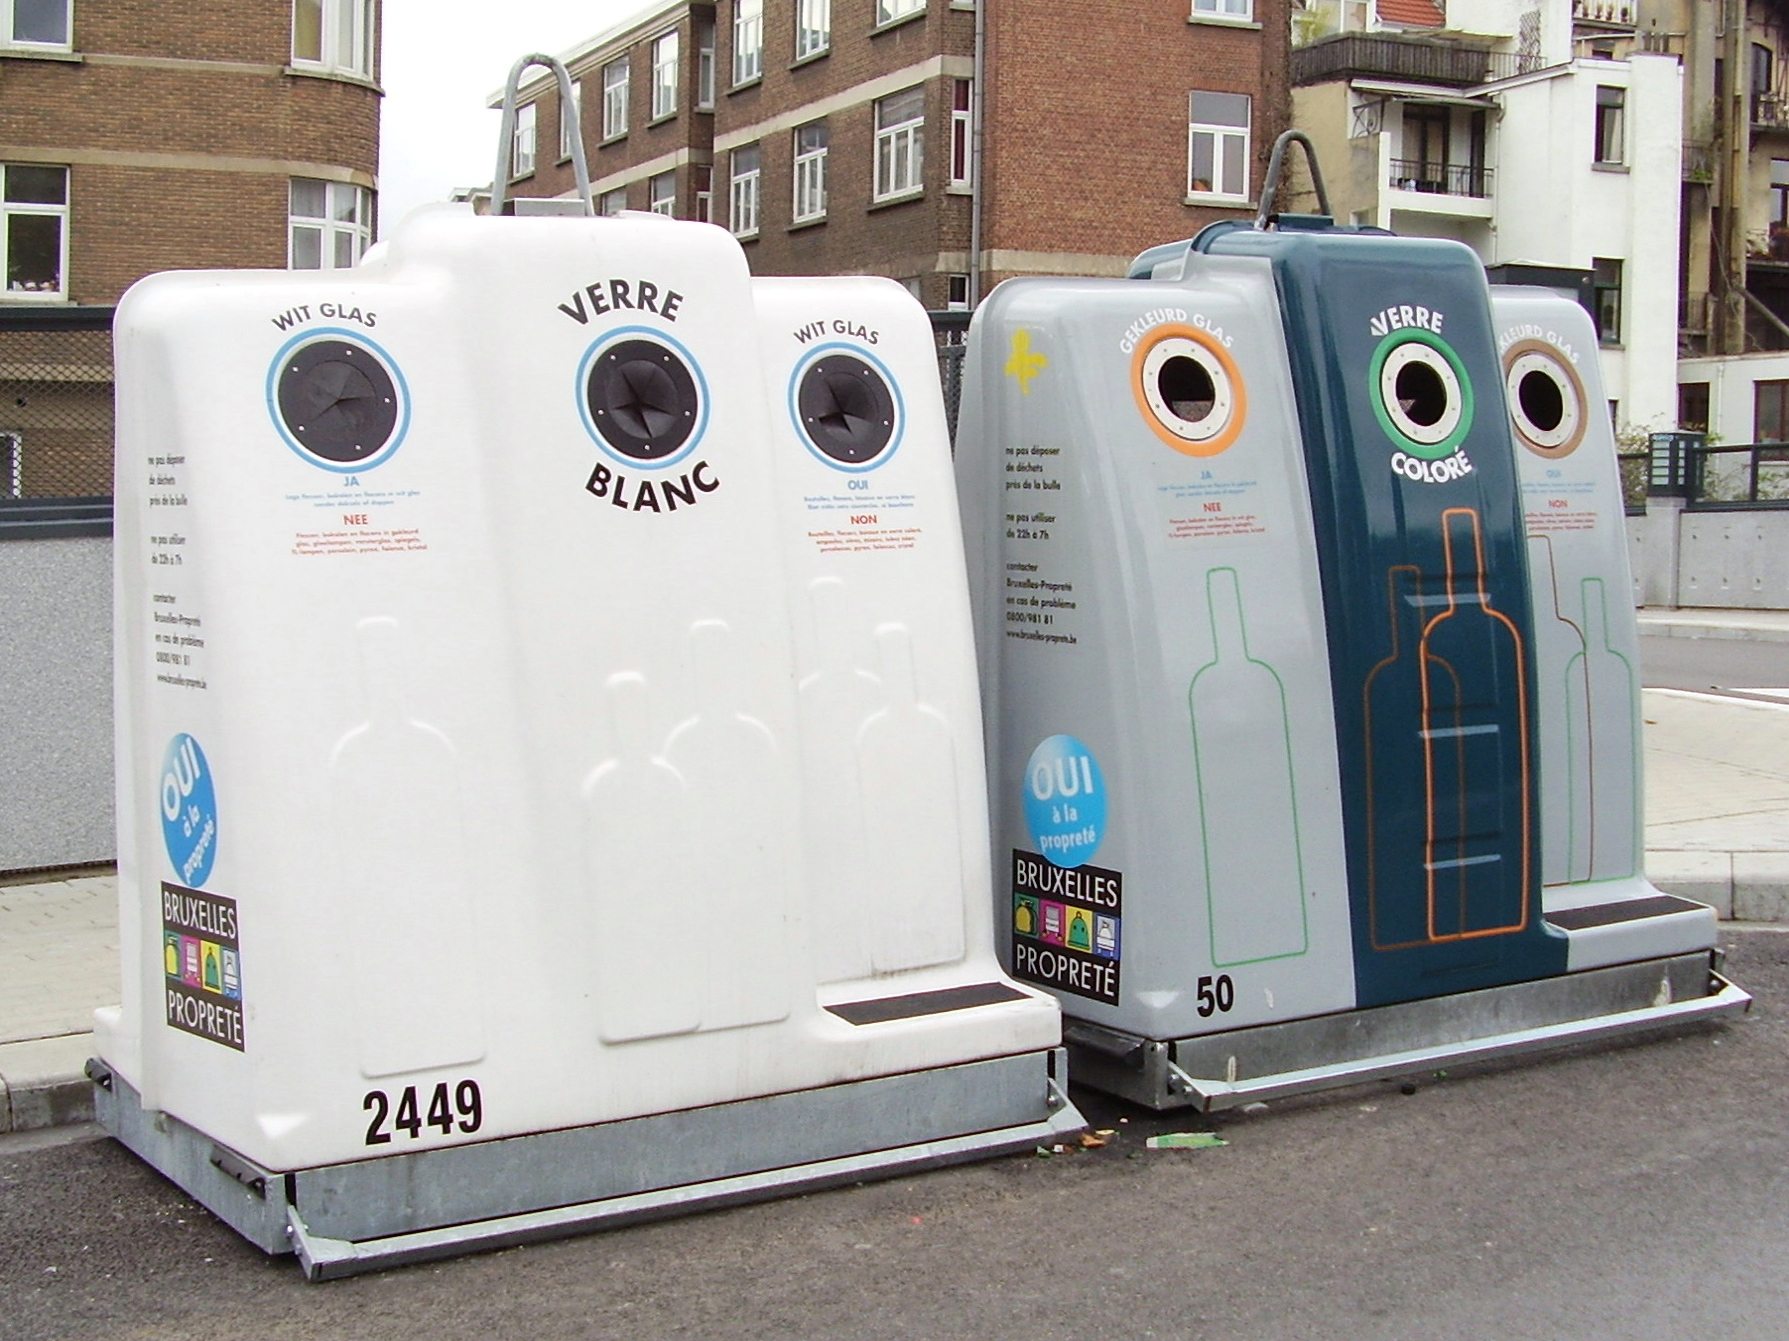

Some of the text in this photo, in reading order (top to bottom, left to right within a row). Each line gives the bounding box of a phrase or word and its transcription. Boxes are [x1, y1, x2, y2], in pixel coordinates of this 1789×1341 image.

[271, 303, 377, 331] WIT GLAS
[557, 279, 684, 325] VERRE
[1370, 305, 1444, 336] VERRE
[793, 319, 880, 345] WIT GLAS
[1119, 308, 1234, 354] GEKLEURD GLAS
[1546, 331, 1580, 363] GLAS
[344, 476, 360, 487] JA
[1391, 445, 1473, 484] COLORÉ
[585, 460, 720, 513] BLANC
[847, 480, 868, 490] OUI
[344, 514, 369, 526] NEE
[850, 515, 878, 525] NON
[1203, 502, 1222, 512] NEE
[162, 736, 202, 823] OUI
[1031, 755, 1094, 801] OUI
[190, 803, 200, 829] la
[1053, 803, 1078, 824] à la
[182, 812, 215, 886] propreté
[1039, 824, 1097, 853] propreté
[1016, 858, 1118, 908] BRUXELLES
[163, 889, 237, 940] BRUXELLES
[1016, 943, 1116, 997] PROPRETÉ
[1197, 974, 1234, 1018] 50
[167, 987, 243, 1045] PROPRETÉ
[363, 1079, 482, 1146] 2449
